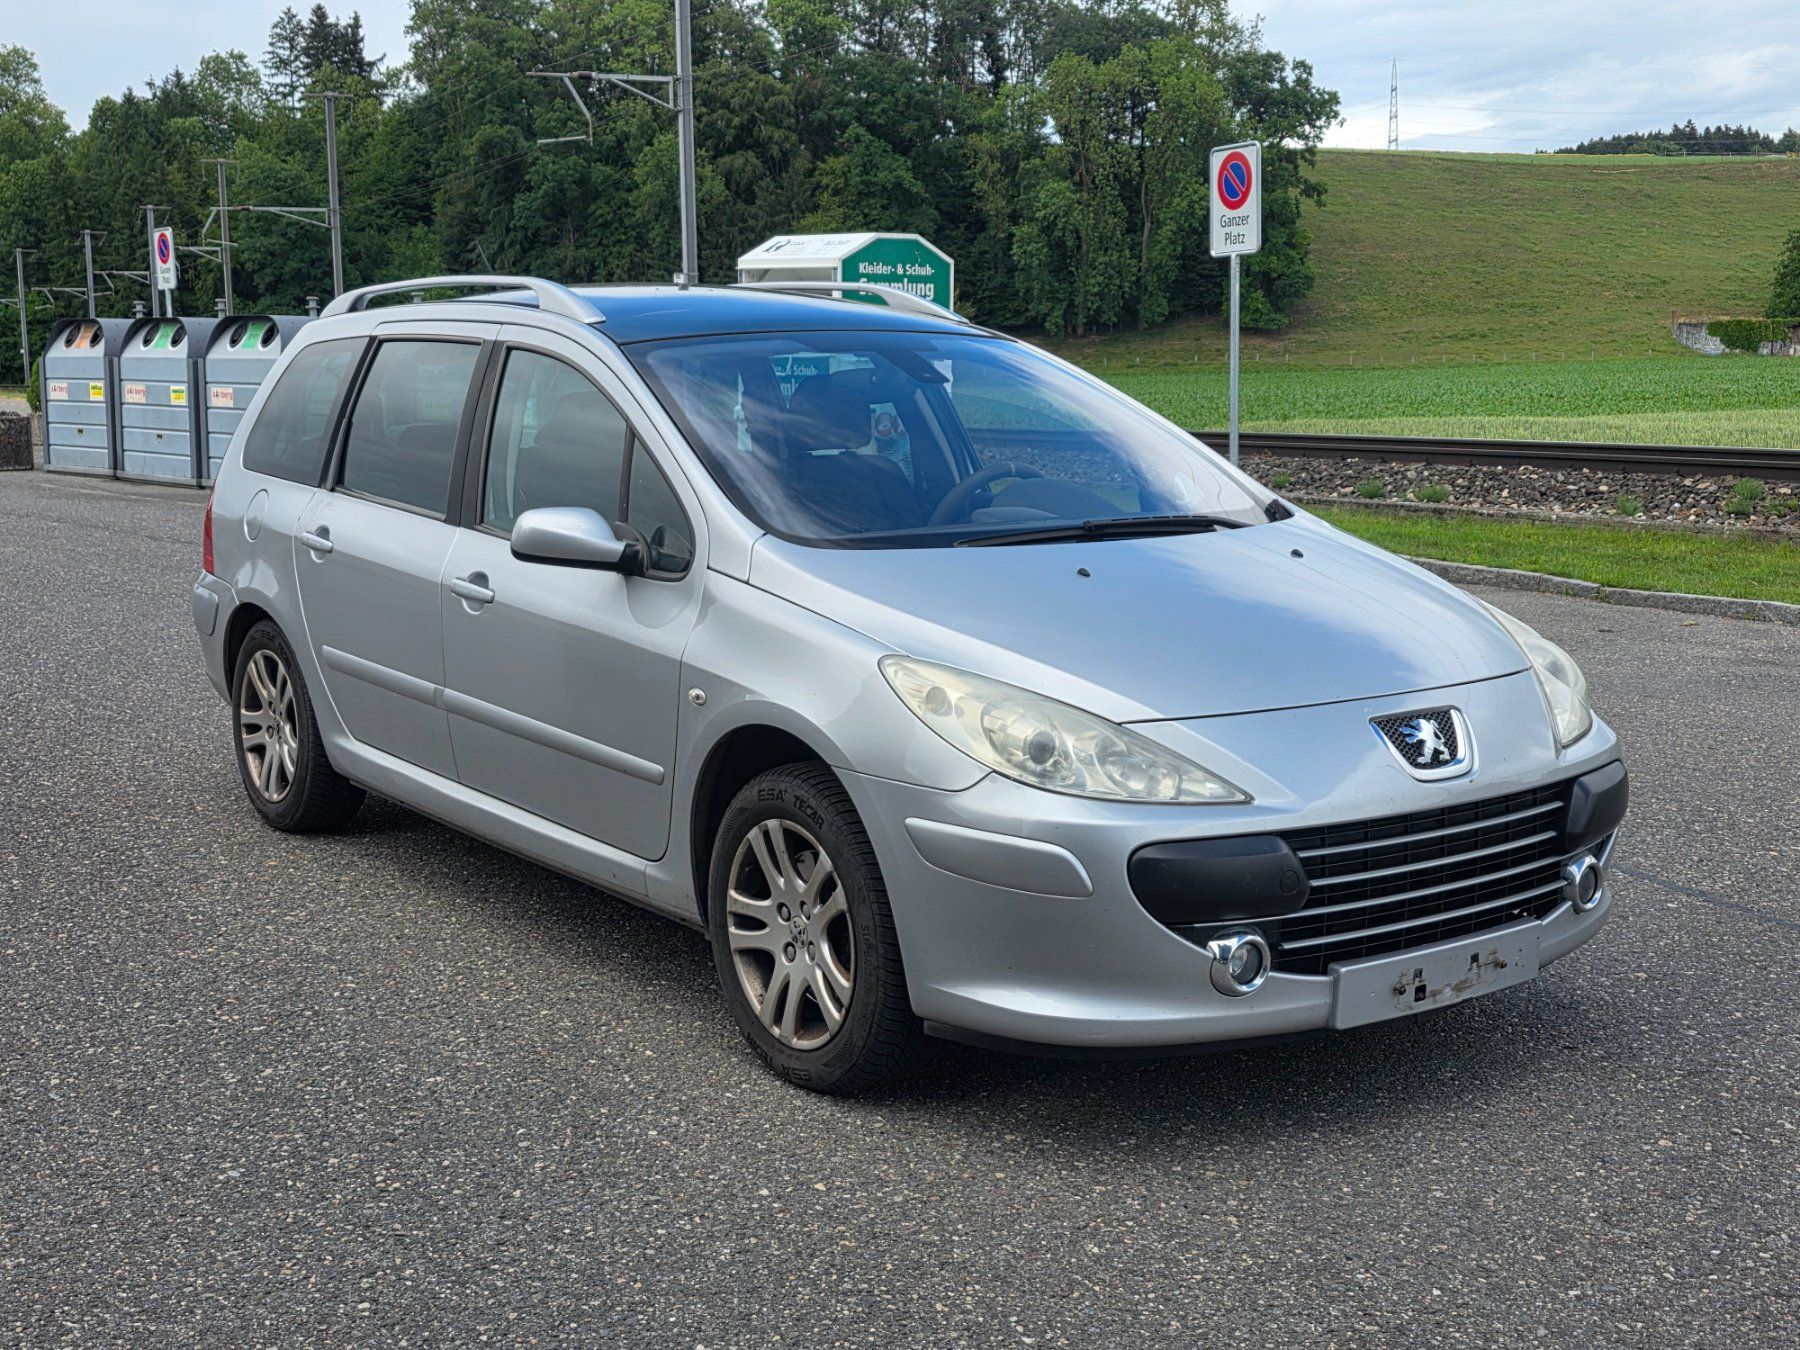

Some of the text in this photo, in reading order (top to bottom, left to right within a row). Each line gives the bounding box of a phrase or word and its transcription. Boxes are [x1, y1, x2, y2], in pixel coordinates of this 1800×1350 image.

[1220, 214, 1250, 228] Ganzer
[1224, 231, 1246, 245] Platz
[859, 262, 935, 276] Kleider- & Schuh-
